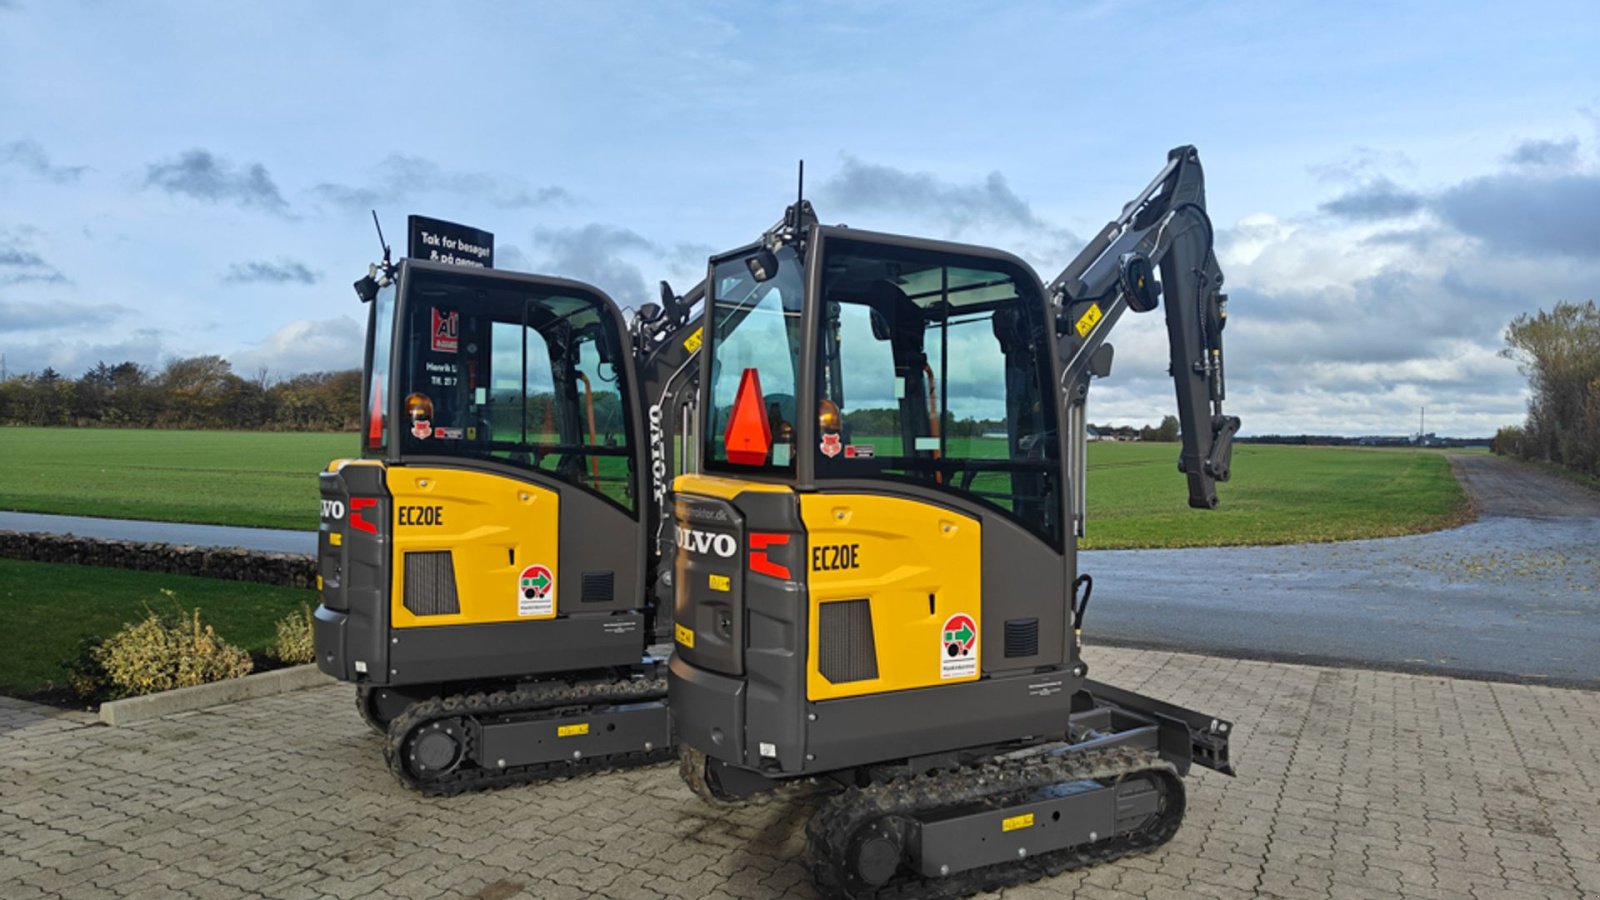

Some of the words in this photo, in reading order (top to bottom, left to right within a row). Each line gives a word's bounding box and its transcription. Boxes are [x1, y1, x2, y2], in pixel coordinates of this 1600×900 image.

[421, 232, 440, 246] Tak
[442, 236, 457, 249] for
[458, 239, 490, 258] besøget
[398, 506, 443, 526] EC20E
[812, 544, 860, 571] EC20E
